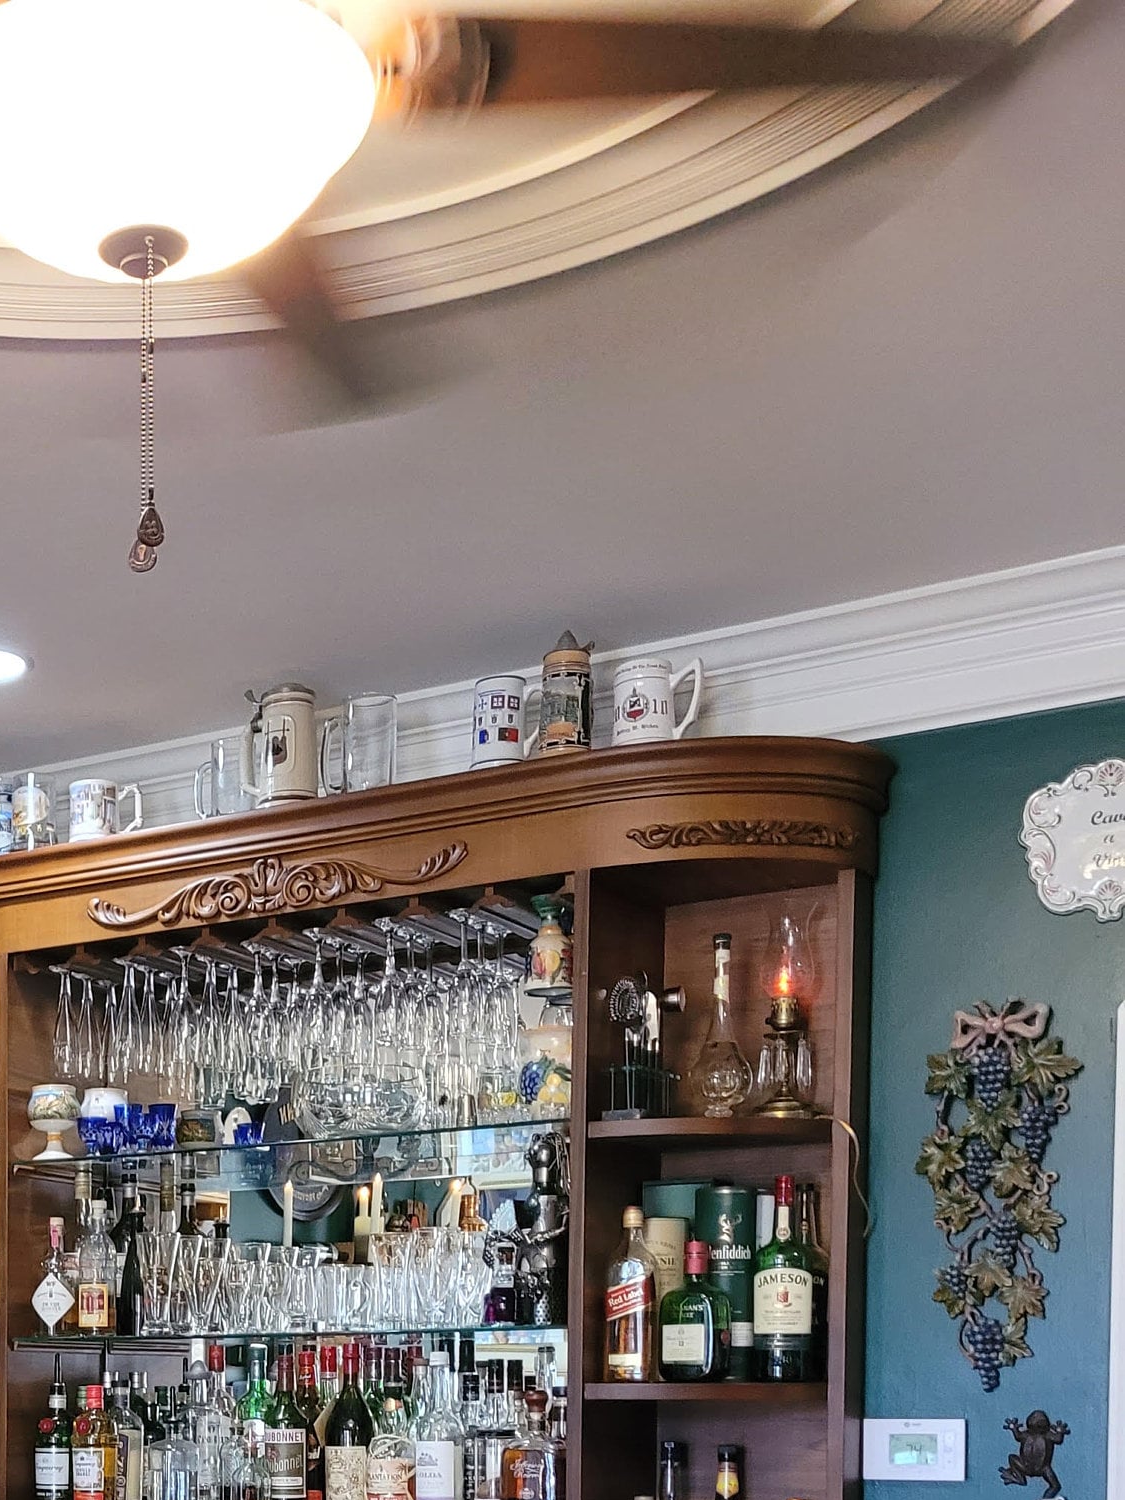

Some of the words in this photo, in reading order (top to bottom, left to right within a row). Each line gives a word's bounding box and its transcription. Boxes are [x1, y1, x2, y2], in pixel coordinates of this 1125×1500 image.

[708, 1244, 752, 1260] enfiddich
[757, 1273, 810, 1288] JAMESON
[607, 1295, 623, 1307] Red
[266, 1431, 304, 1442] UBONNET
[268, 1454, 303, 1473] ubonnet
